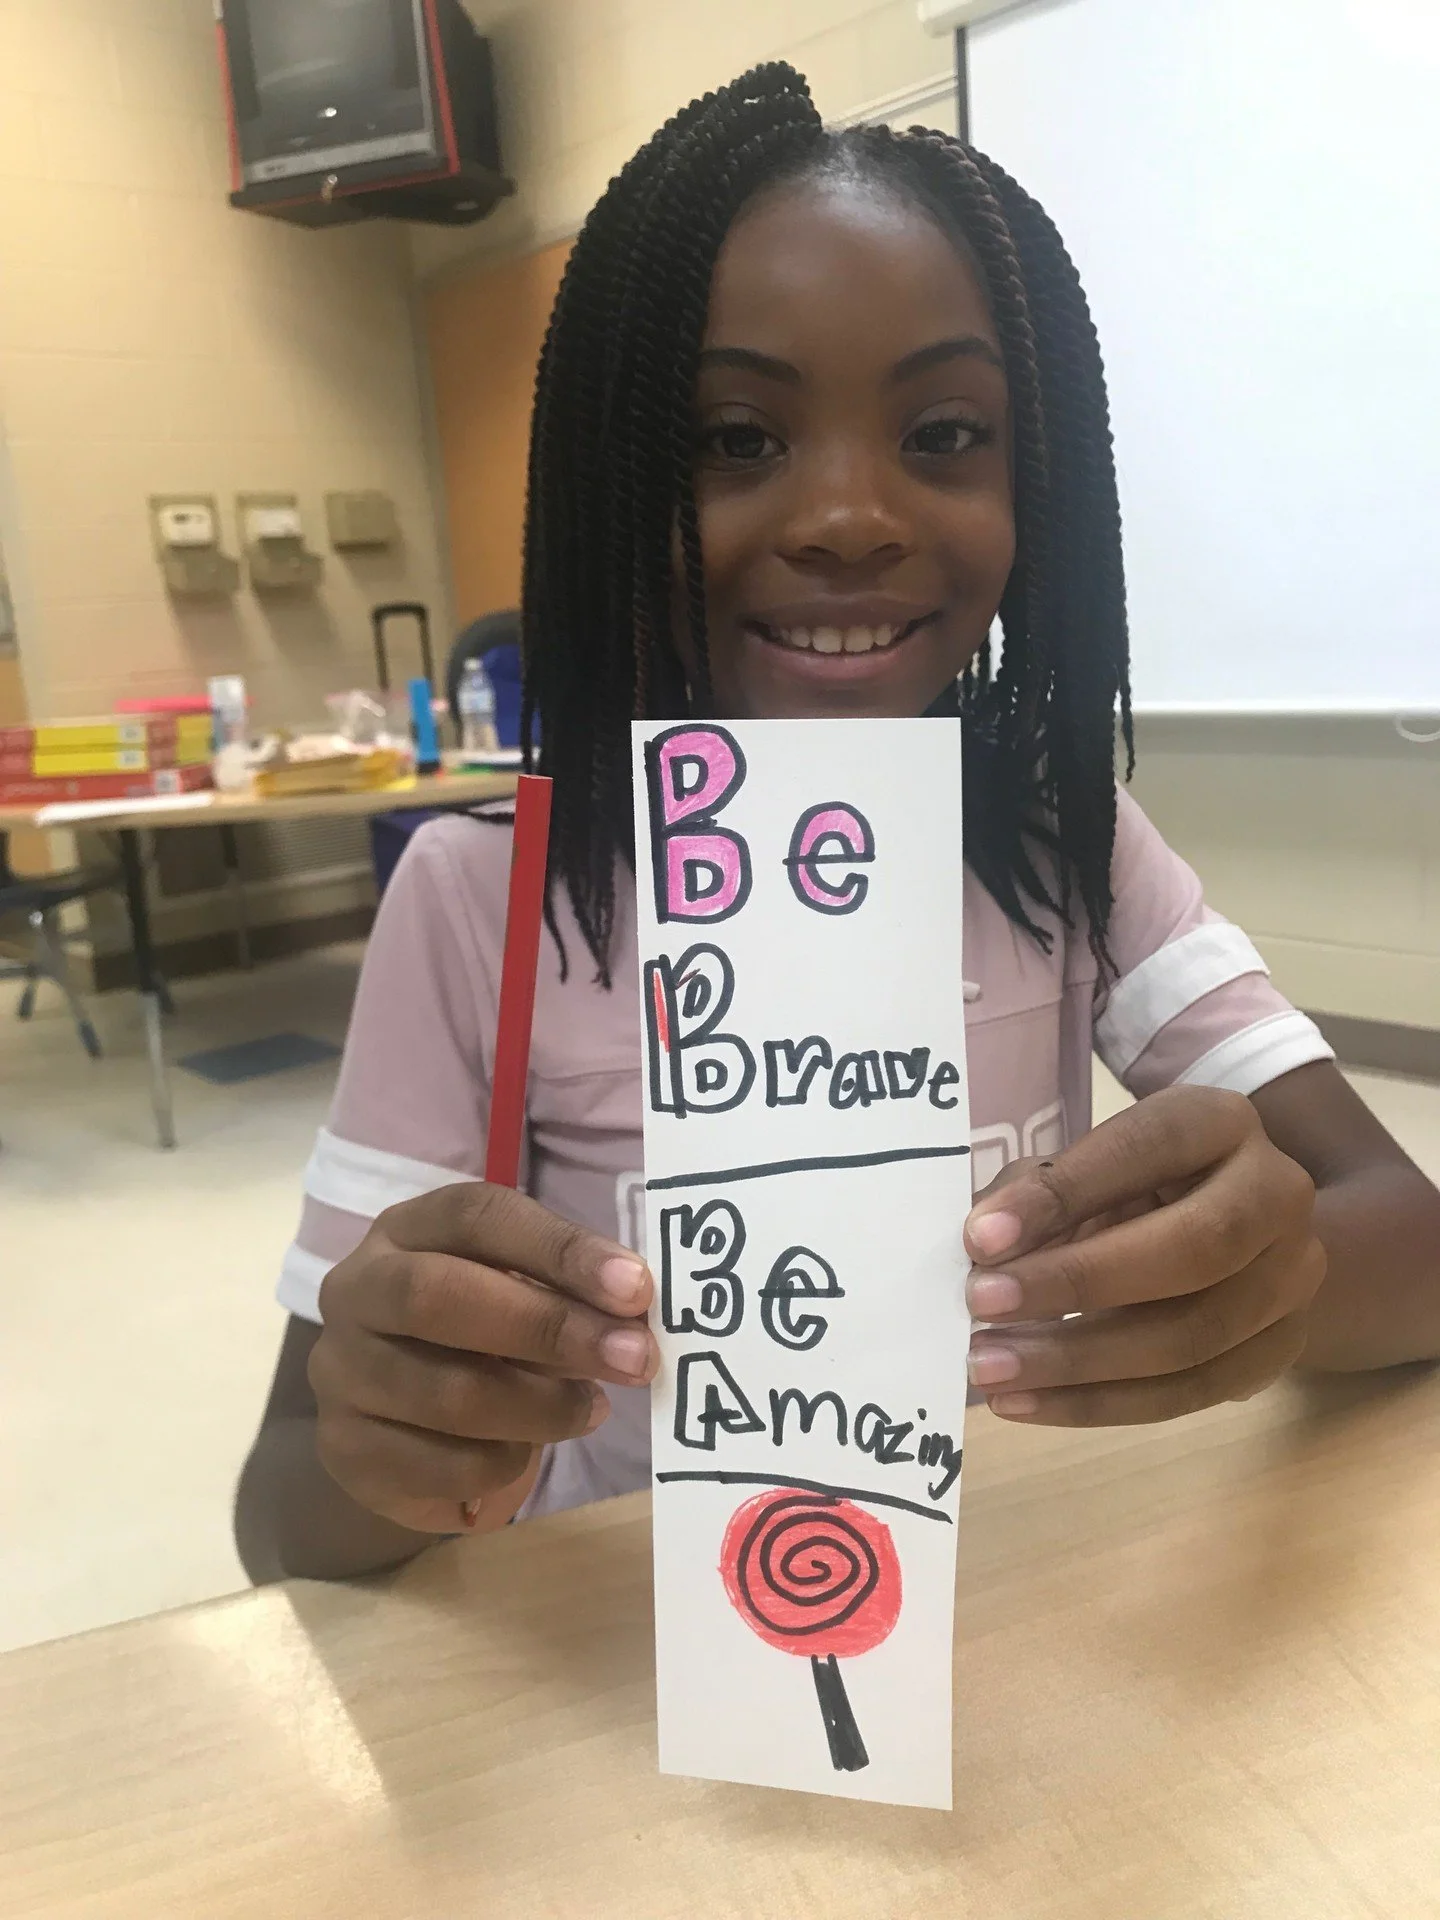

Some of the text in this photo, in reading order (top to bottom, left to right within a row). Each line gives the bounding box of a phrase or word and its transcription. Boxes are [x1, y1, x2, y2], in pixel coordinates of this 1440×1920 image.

[643, 723, 875, 924] Be
[643, 942, 960, 1119] Brave
[660, 1199, 845, 1351] Be
[673, 1350, 963, 1500] Amazing
